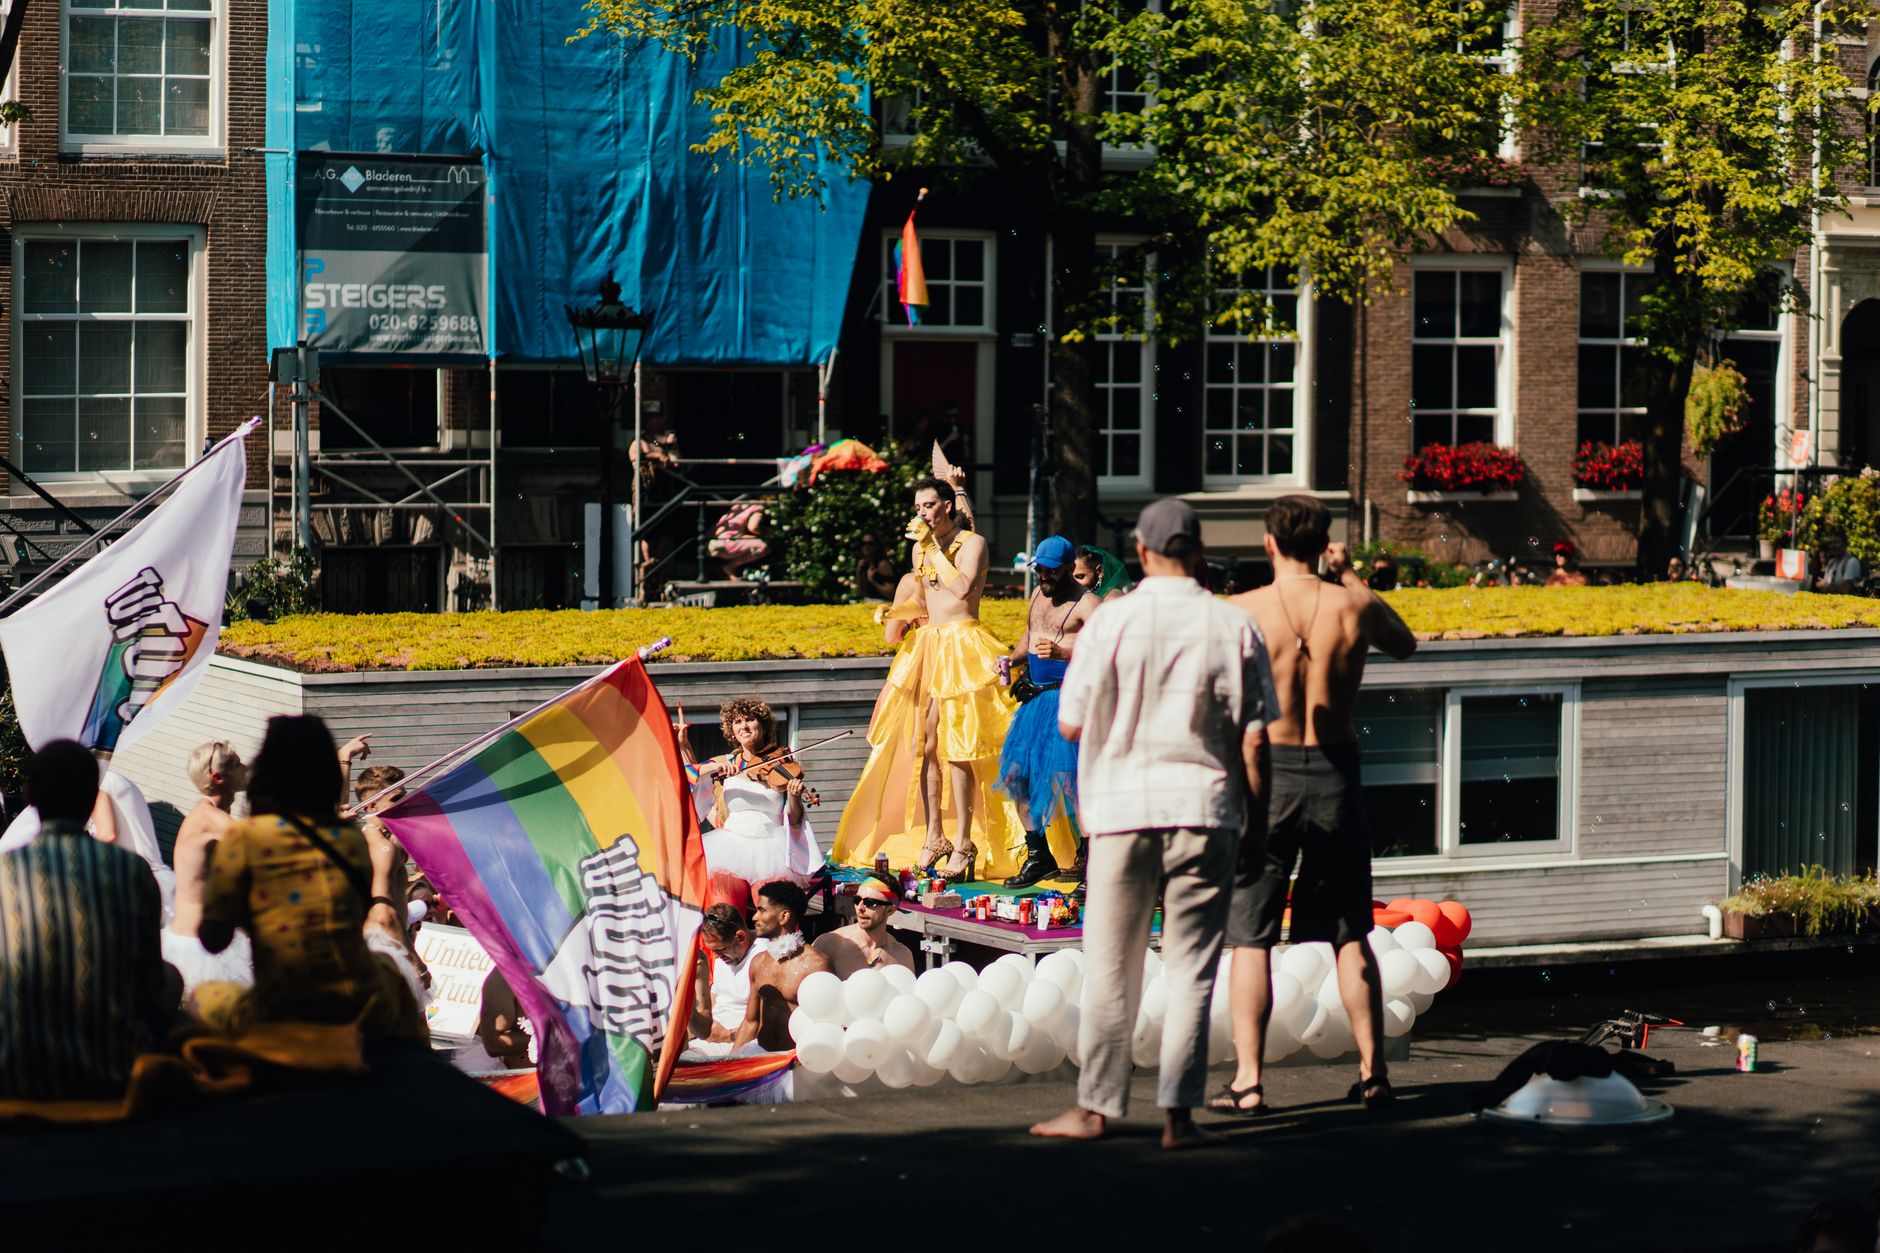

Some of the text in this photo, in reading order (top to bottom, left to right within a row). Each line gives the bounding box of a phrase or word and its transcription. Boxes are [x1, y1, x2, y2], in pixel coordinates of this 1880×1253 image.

[365, 169, 412, 182] Bladeren
[304, 283, 447, 309] STEIGERS
[369, 314, 479, 332] 020-6259688
